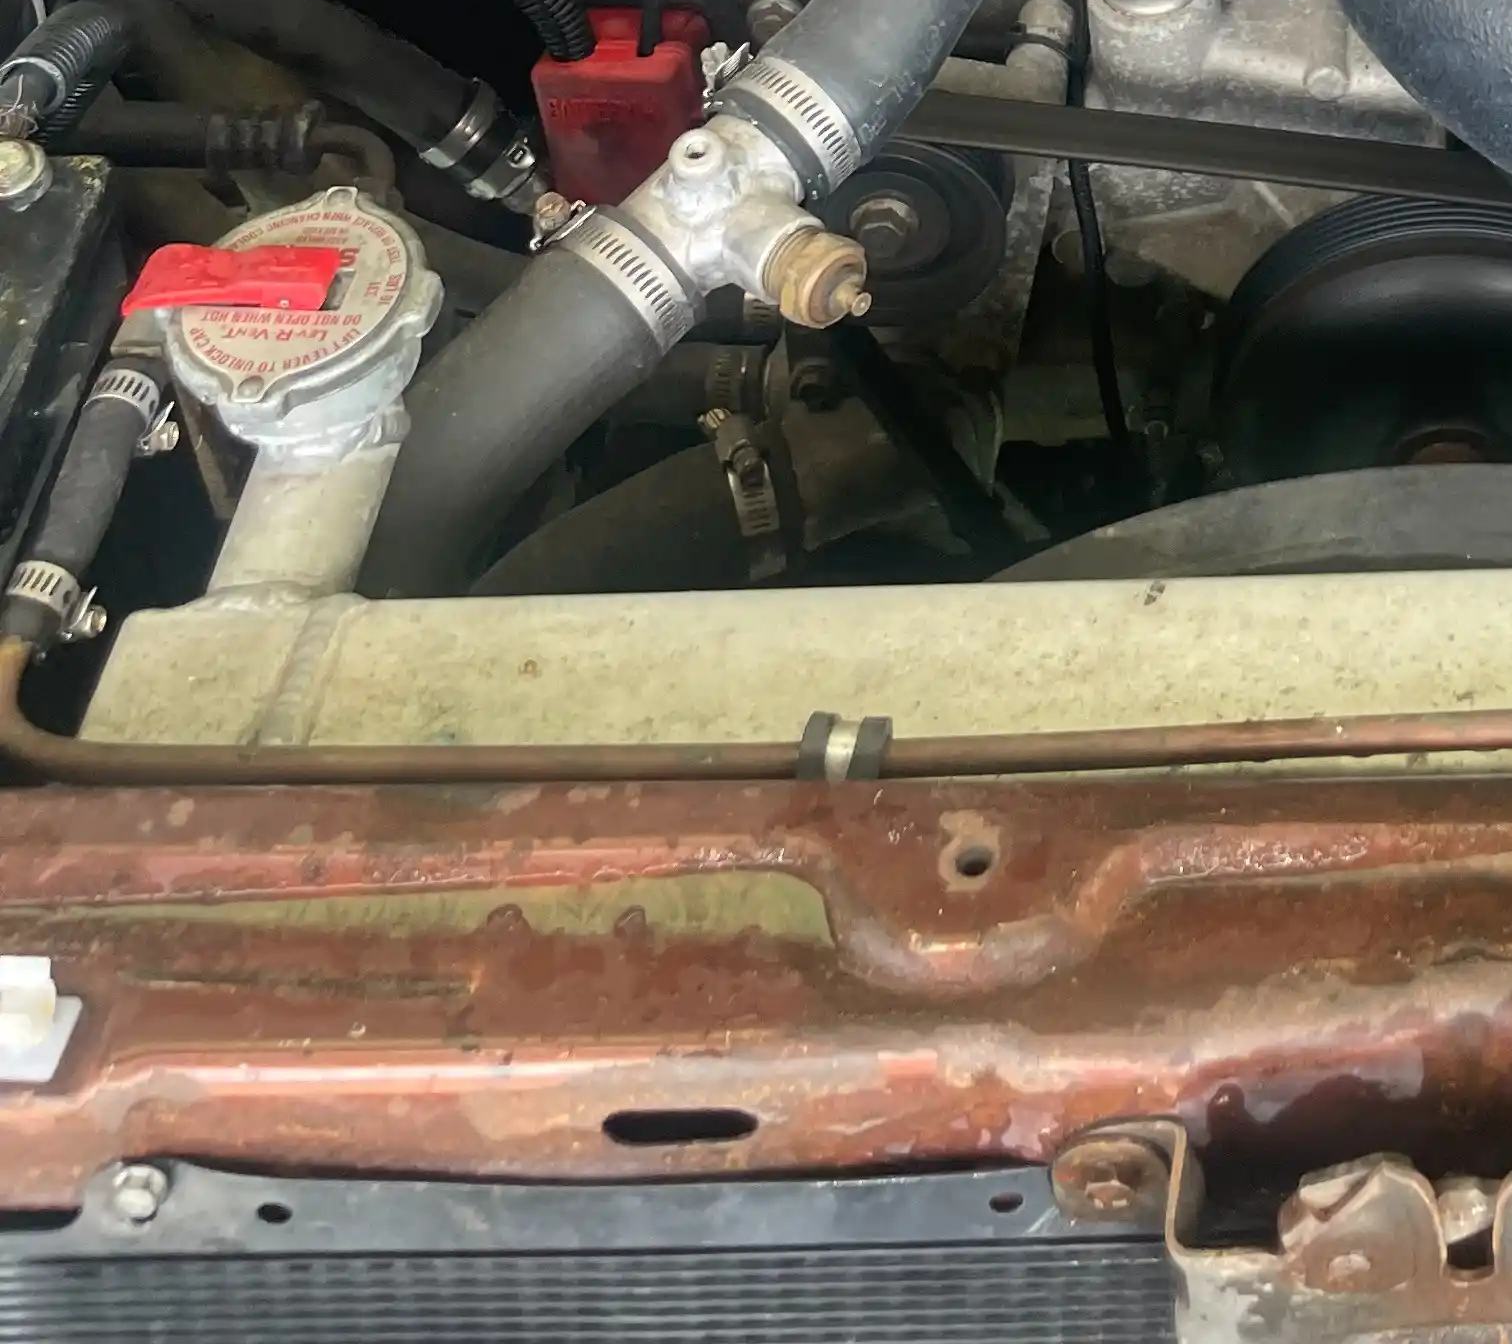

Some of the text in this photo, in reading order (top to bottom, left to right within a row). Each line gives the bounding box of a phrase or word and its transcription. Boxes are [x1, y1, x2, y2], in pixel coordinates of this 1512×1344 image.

[200, 311, 362, 325] DO NOT OPEN WHEN HOT
[190, 327, 210, 350] CAP
[206, 344, 254, 372] UNLOCK
[258, 361, 276, 372] TO
[283, 347, 328, 370] LEVER
